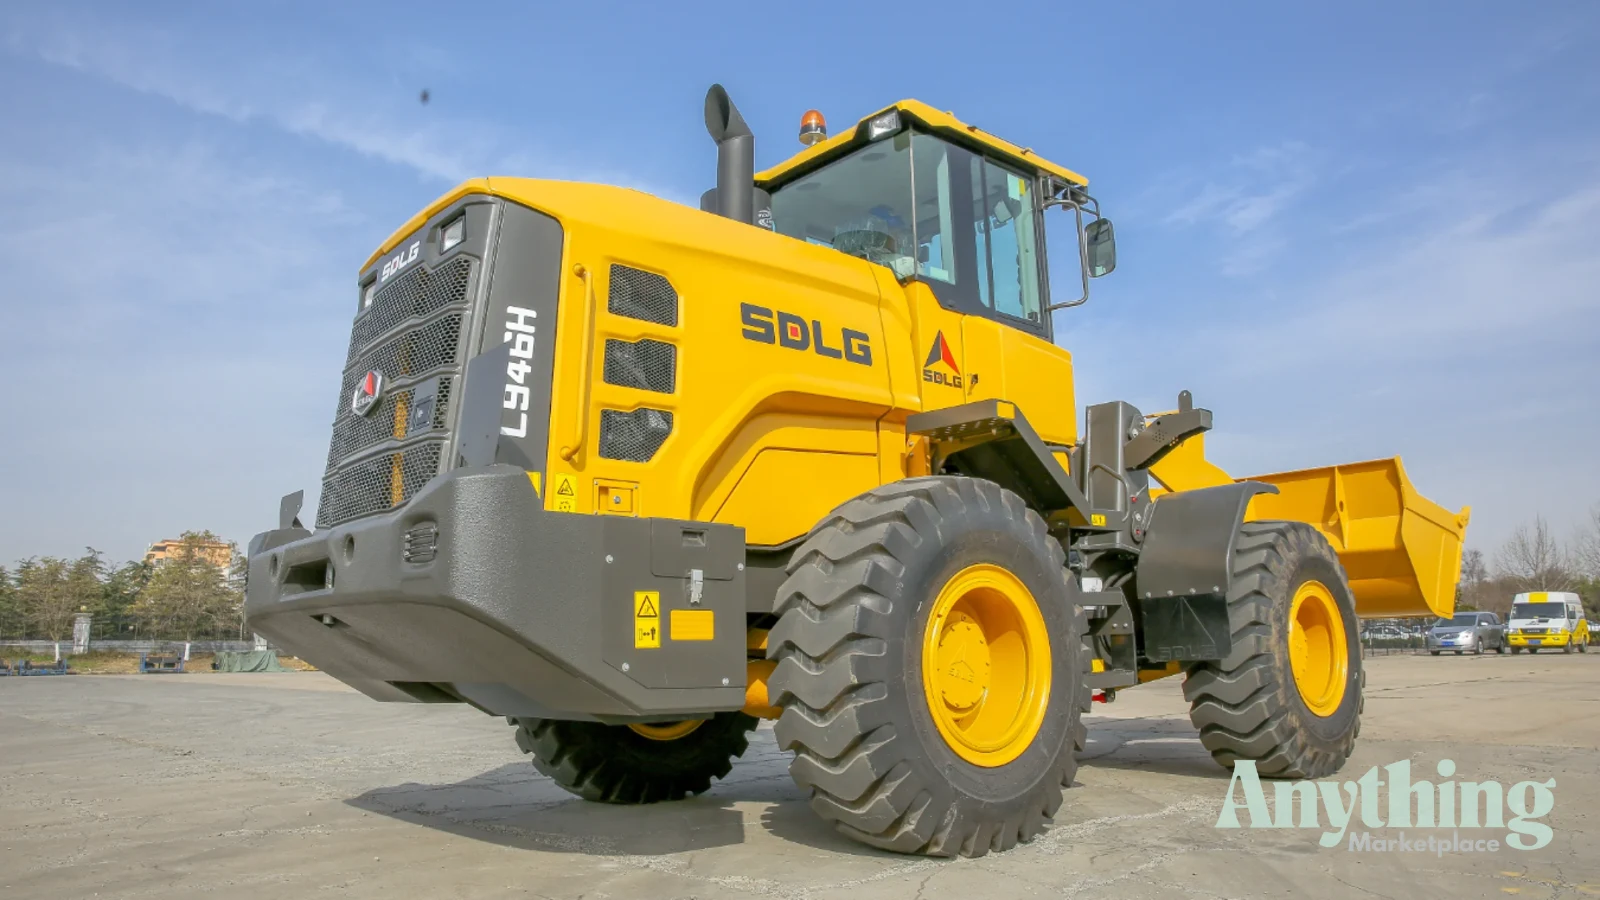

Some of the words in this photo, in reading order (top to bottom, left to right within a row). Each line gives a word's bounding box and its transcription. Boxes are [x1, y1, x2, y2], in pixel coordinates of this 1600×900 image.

[381, 240, 420, 282] SDLG
[740, 301, 873, 367] SDLG
[500, 305, 537, 438] L946H
[922, 368, 962, 389] SDLG
